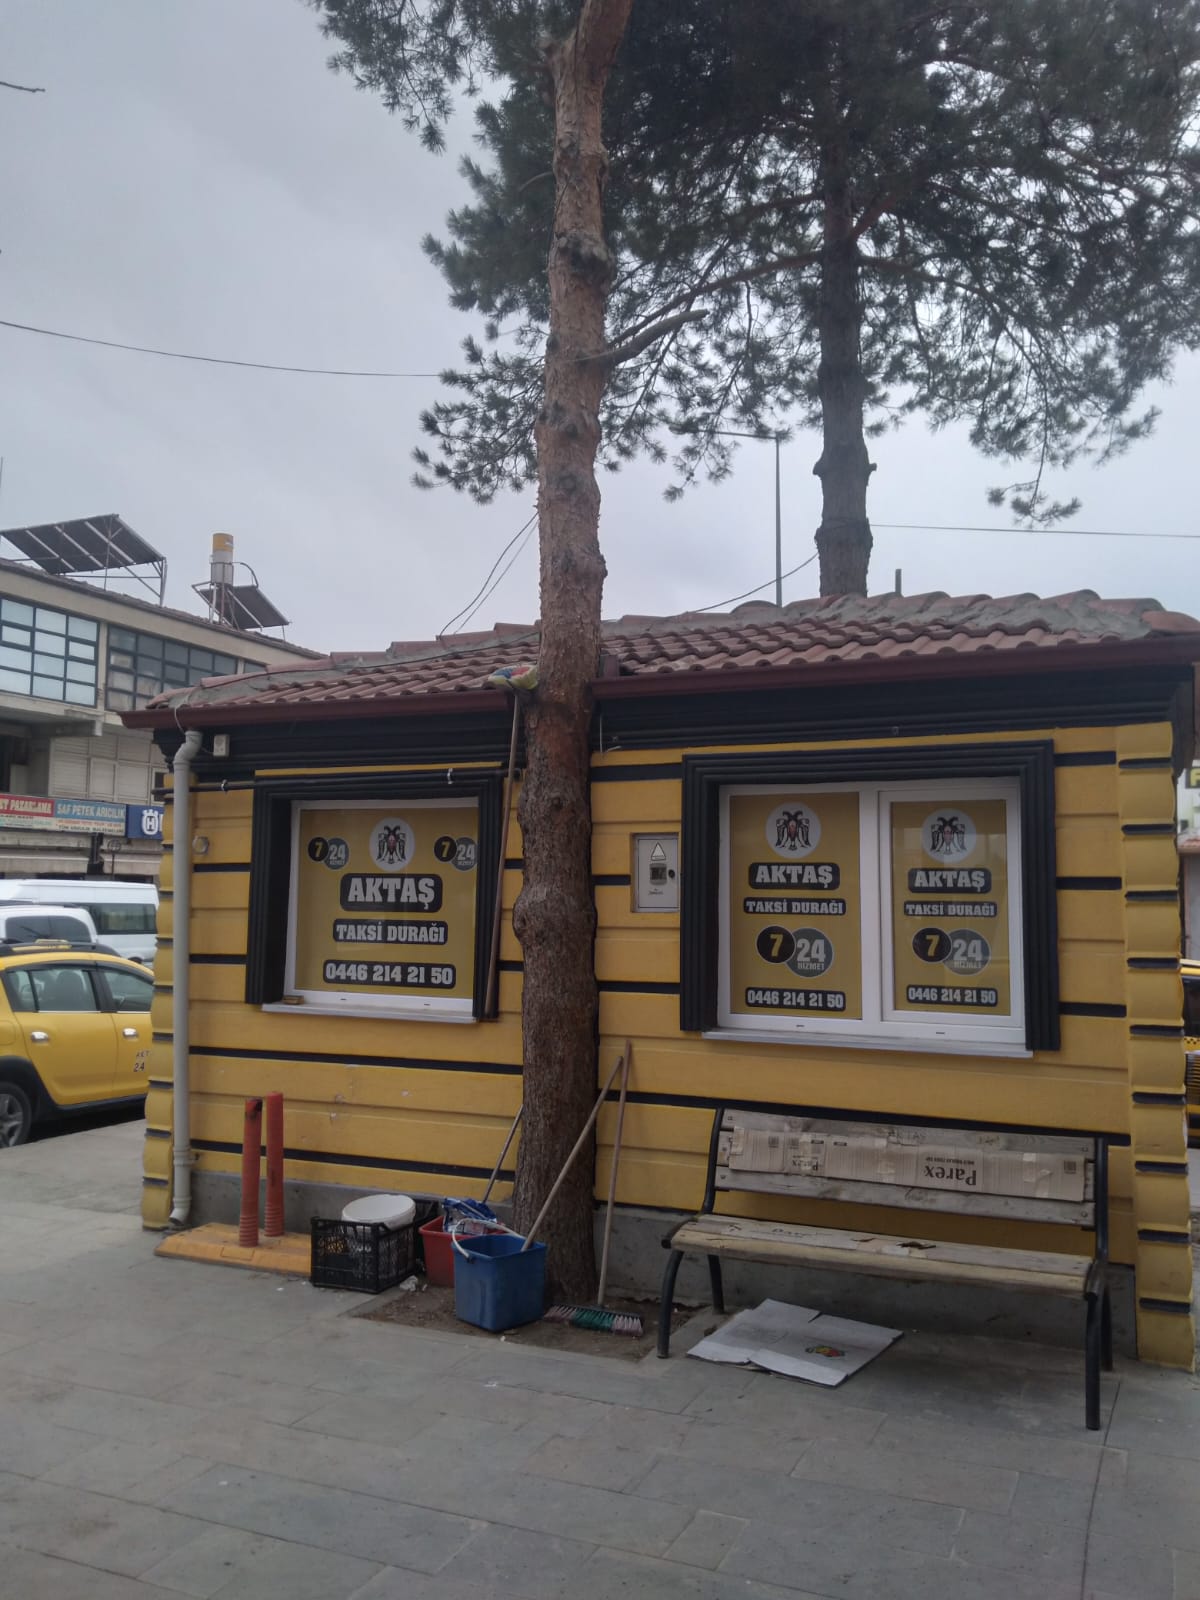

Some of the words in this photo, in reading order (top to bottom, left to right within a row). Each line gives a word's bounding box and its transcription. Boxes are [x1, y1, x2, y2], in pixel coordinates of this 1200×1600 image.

[57, 803, 70, 815] SAF
[71, 804, 95, 817] PETEK
[96, 805, 126, 818] ARICILIK
[315, 841, 322, 858] 7
[329, 844, 346, 860] 24
[441, 841, 450, 858] 7
[457, 844, 475, 860] 24
[755, 865, 833, 888] AKTAŞ
[914, 870, 985, 892] AKTAŞ
[348, 877, 435, 910] AKTAŞ
[746, 899, 788, 914] TAKSİ
[791, 900, 843, 915] DURAĞI
[906, 902, 944, 916] TAKSİ
[947, 903, 995, 917] DURAĞI
[336, 921, 382, 941] TAKSİ
[387, 922, 445, 943] DURAĞI
[769, 933, 784, 957] 7
[796, 938, 825, 962] 24
[925, 934, 941, 957] 7
[952, 939, 982, 962] 24
[326, 963, 367, 981] 0446
[373, 965, 401, 983] 214
[407, 966, 425, 983] 21
[431, 968, 453, 985] 50
[747, 990, 778, 1005] 0446
[783, 991, 805, 1006] 214
[809, 993, 823, 1007] 21
[827, 994, 844, 1009] 50
[908, 987, 938, 1000] 0446
[941, 989, 962, 1002] 214
[965, 990, 977, 1003] 21
[980, 991, 996, 1004] 50
[925, 1165, 977, 1186] Parex
